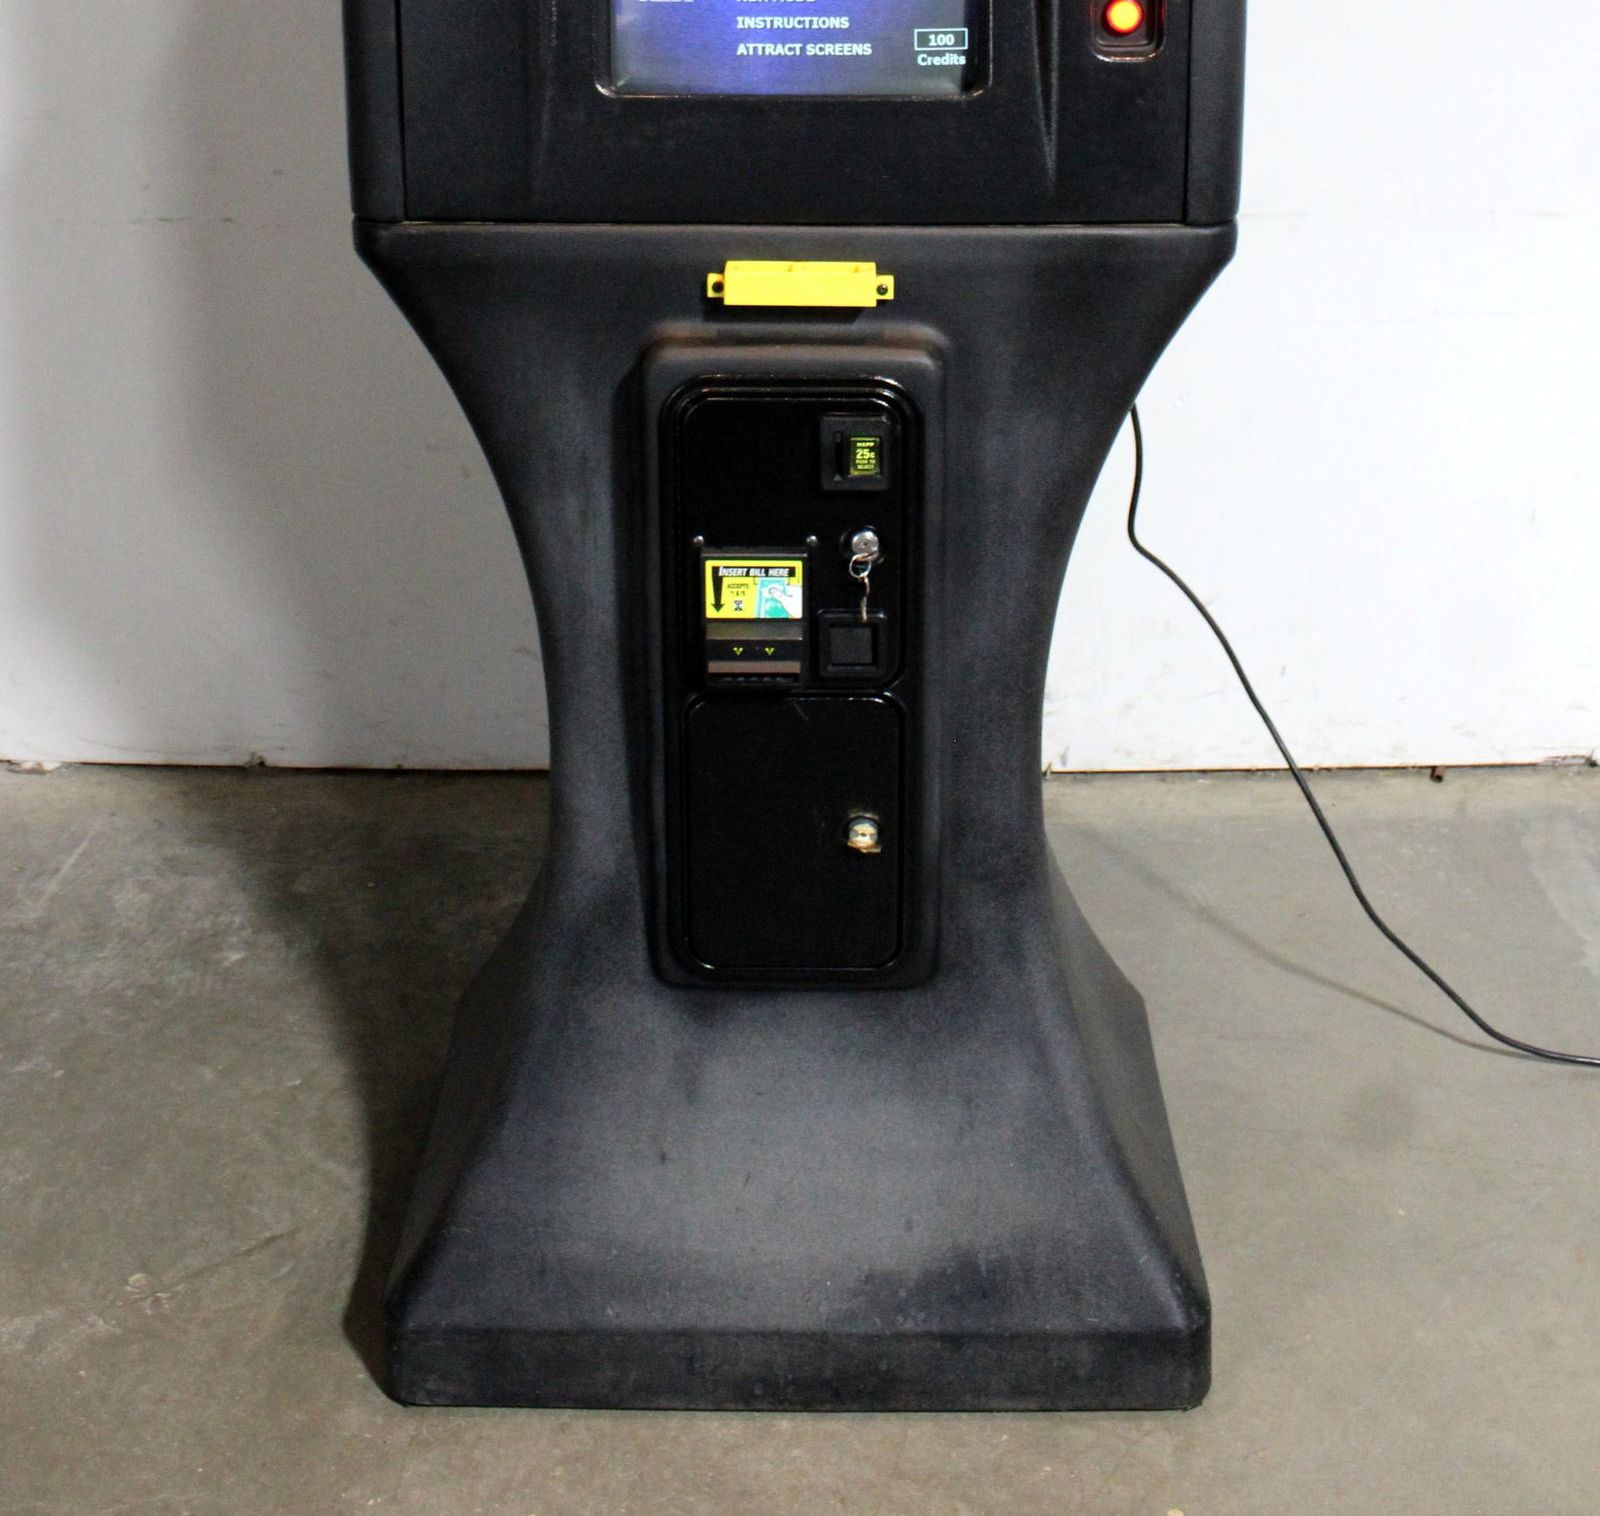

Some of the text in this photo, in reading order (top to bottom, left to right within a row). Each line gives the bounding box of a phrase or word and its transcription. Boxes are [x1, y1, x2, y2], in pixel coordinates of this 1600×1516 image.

[736, 16, 850, 29] INSTRUCTIONS
[928, 34, 955, 46] 100
[737, 43, 872, 56] ATTRACT SCREENS
[917, 53, 966, 66] Credits
